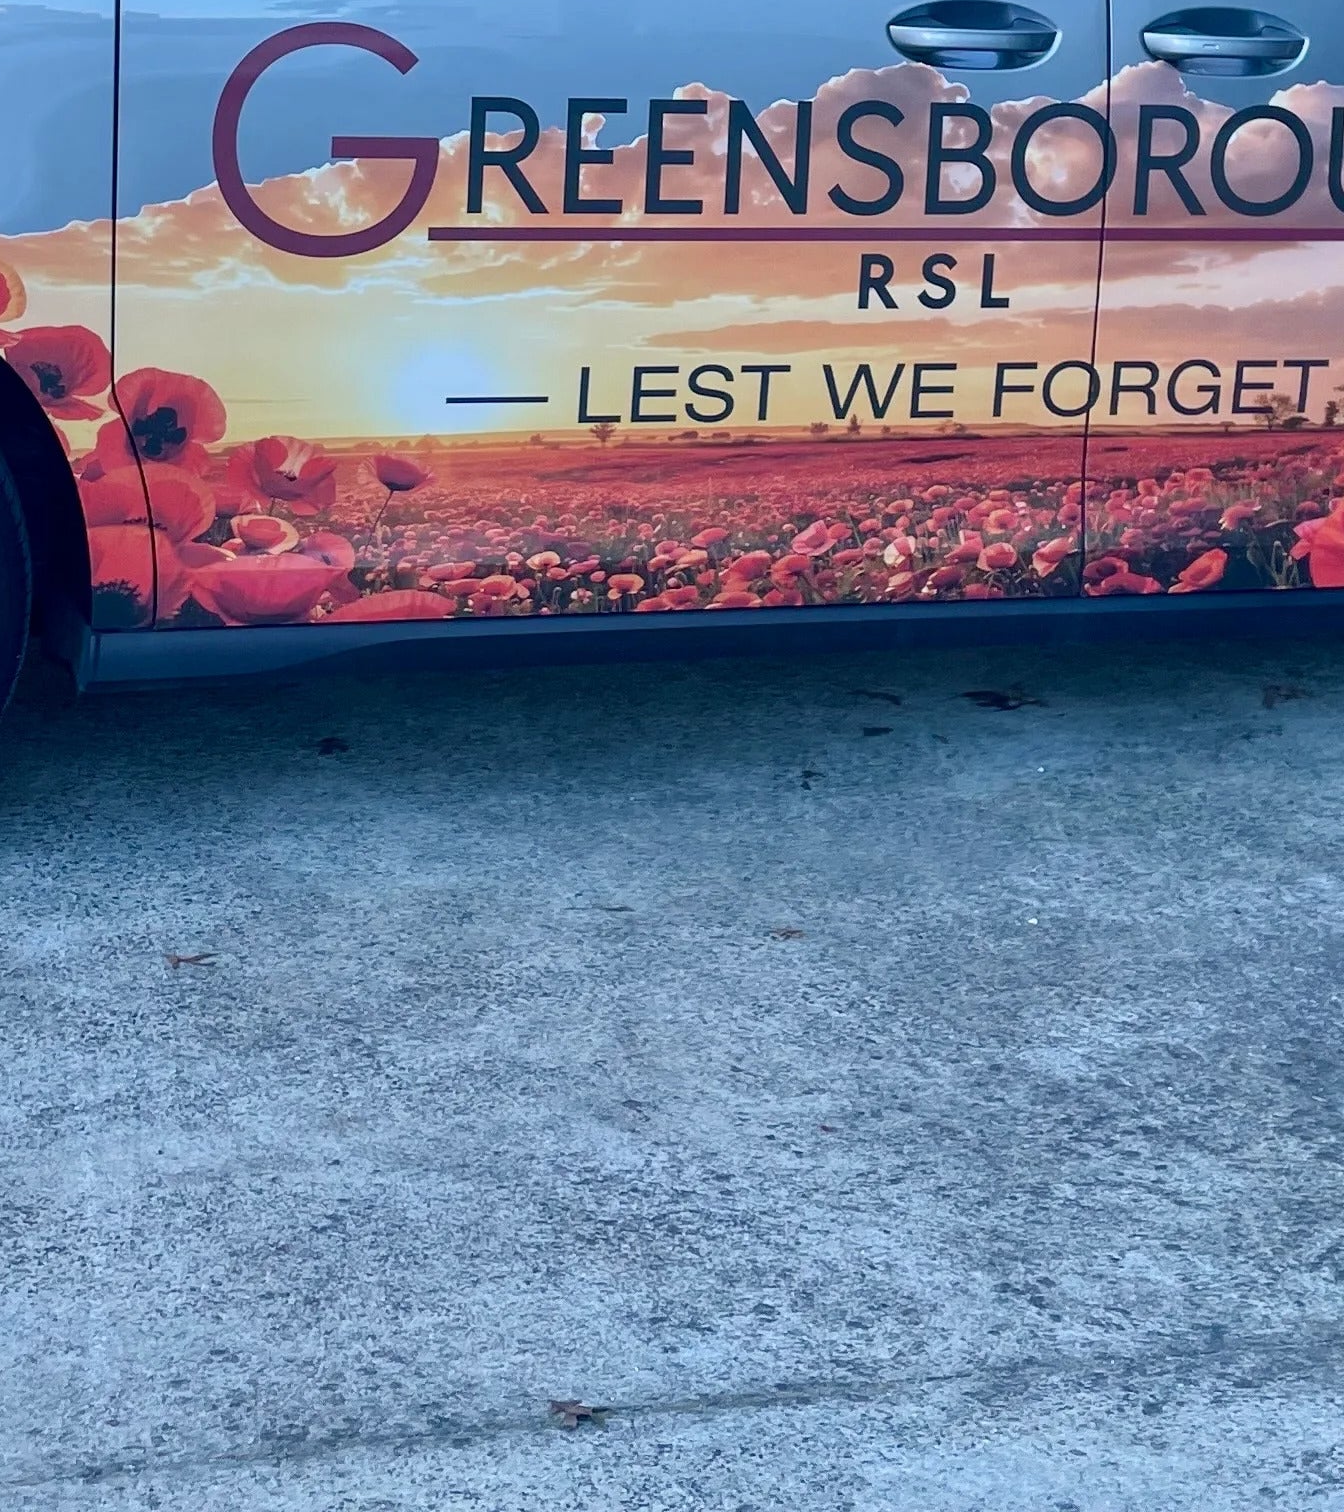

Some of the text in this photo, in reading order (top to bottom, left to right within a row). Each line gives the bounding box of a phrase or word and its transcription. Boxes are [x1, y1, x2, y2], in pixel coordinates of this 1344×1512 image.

[858, 252, 1011, 310] RSL
[577, 357, 1331, 424] LEST WE FORGET
